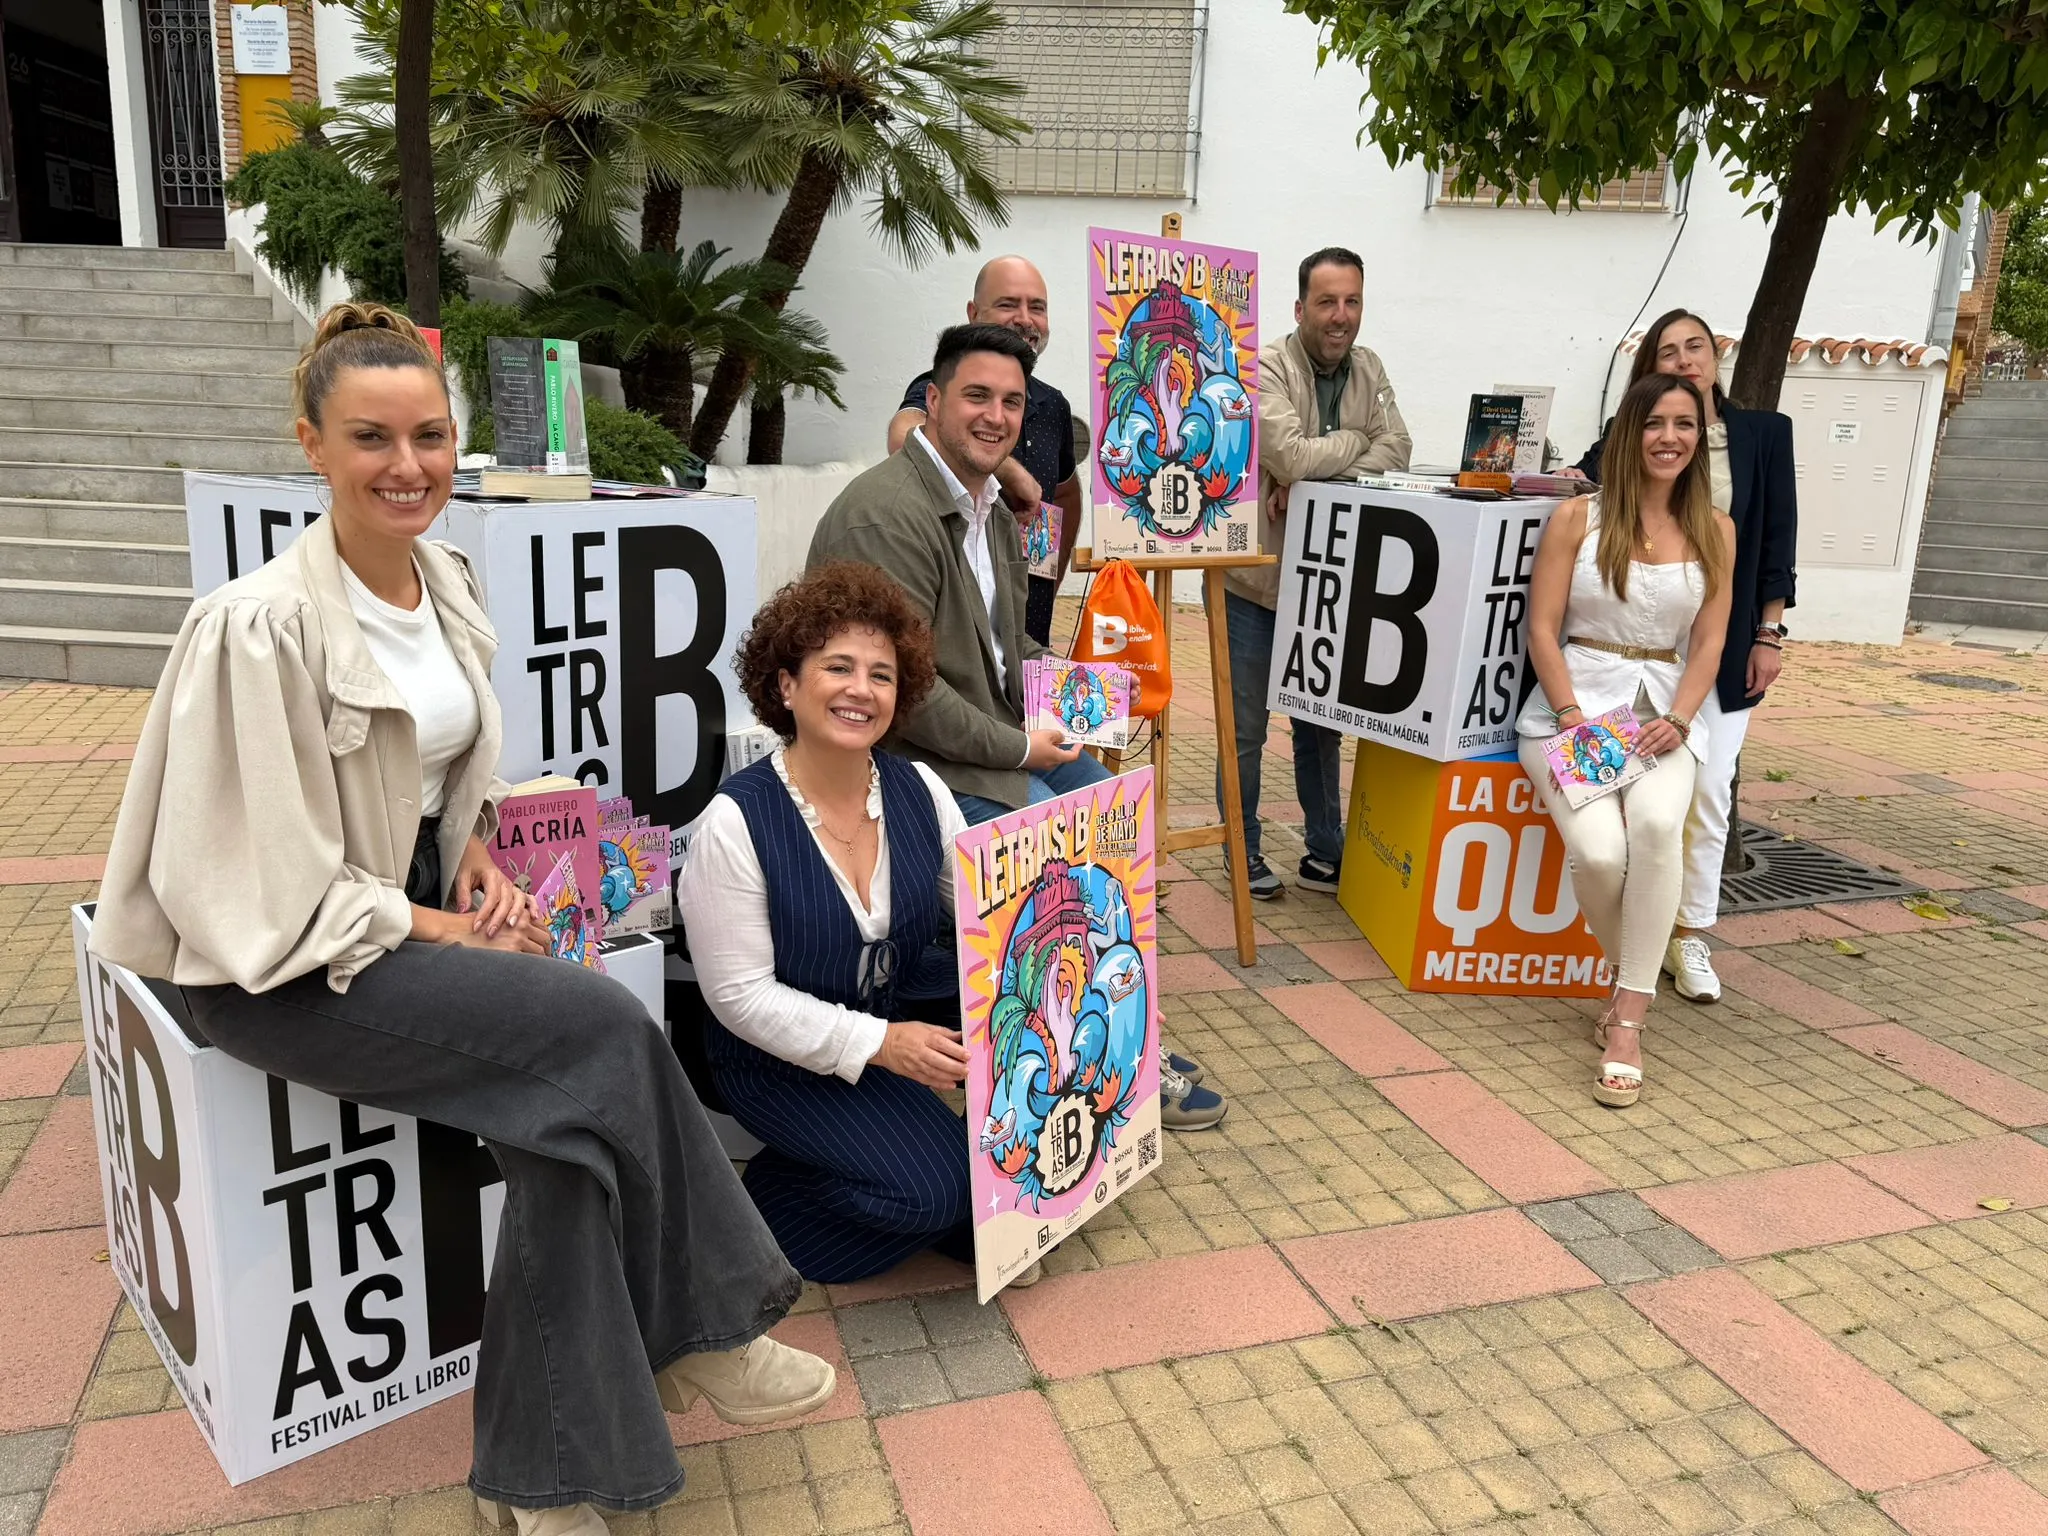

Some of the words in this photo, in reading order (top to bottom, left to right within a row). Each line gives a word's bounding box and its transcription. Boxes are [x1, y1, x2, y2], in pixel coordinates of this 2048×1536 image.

[9, 53, 29, 75] 26
[1104, 239, 1185, 294] LETRAS
[1192, 253, 1208, 288] B
[1211, 277, 1223, 290] DE
[1227, 280, 1249, 301] MAYO
[1161, 488, 1172, 501] TR
[1161, 501, 1172, 515] AS
[1162, 474, 1172, 487] LE
[1302, 499, 1352, 567] LE
[1491, 518, 1540, 587] LE
[531, 531, 607, 646] LE
[1296, 565, 1342, 634] TR
[1483, 591, 1526, 658] TR
[618, 524, 727, 831] B
[1043, 660, 1066, 671] LETRAS
[1281, 632, 1335, 697] AS
[526, 648, 609, 761] TR
[1278, 692, 1311, 713] FESTIVAL
[1312, 702, 1328, 716] DEL
[1329, 705, 1353, 725] LIBRO
[1354, 712, 1365, 728] DE
[1366, 716, 1429, 747] BENALMÁDENA
[1462, 661, 1515, 729] AS
[1458, 733, 1490, 749] FESTIVAL
[1492, 729, 1505, 744] DEL
[1544, 735, 1570, 754] LETRAS
[502, 804, 536, 820] PABLO
[539, 799, 577, 815] RIVERO
[1095, 813, 1109, 828] DEL
[1109, 810, 1116, 823] 8
[1116, 806, 1127, 821] AL
[1127, 800, 1137, 819] 10
[1448, 775, 1494, 812] LA
[496, 824, 526, 850] LA
[532, 812, 586, 844] CRÍA
[1095, 826, 1108, 843] DE
[1110, 818, 1137, 841] MAYO
[973, 813, 1068, 920] LETRAS
[1074, 805, 1091, 857] B
[85, 943, 120, 1079] LE
[94, 1051, 133, 1189] TR
[1050, 1136, 1063, 1158] TR
[1051, 1117, 1062, 1140] LE
[1051, 1155, 1064, 1179] AS
[109, 1161, 144, 1288] AS
[262, 1158, 403, 1294] TR
[116, 1254, 138, 1305] FESTIVAL
[136, 1291, 149, 1325] DEL
[149, 1319, 165, 1352] LIBRO
[164, 1345, 173, 1369] DE
[172, 1366, 216, 1446] BENALMÁDENA
[273, 1273, 407, 1421] AS
[271, 1397, 366, 1454] FESTIVAL
[373, 1382, 410, 1412] DEL
[415, 1354, 471, 1394] LIBRO
